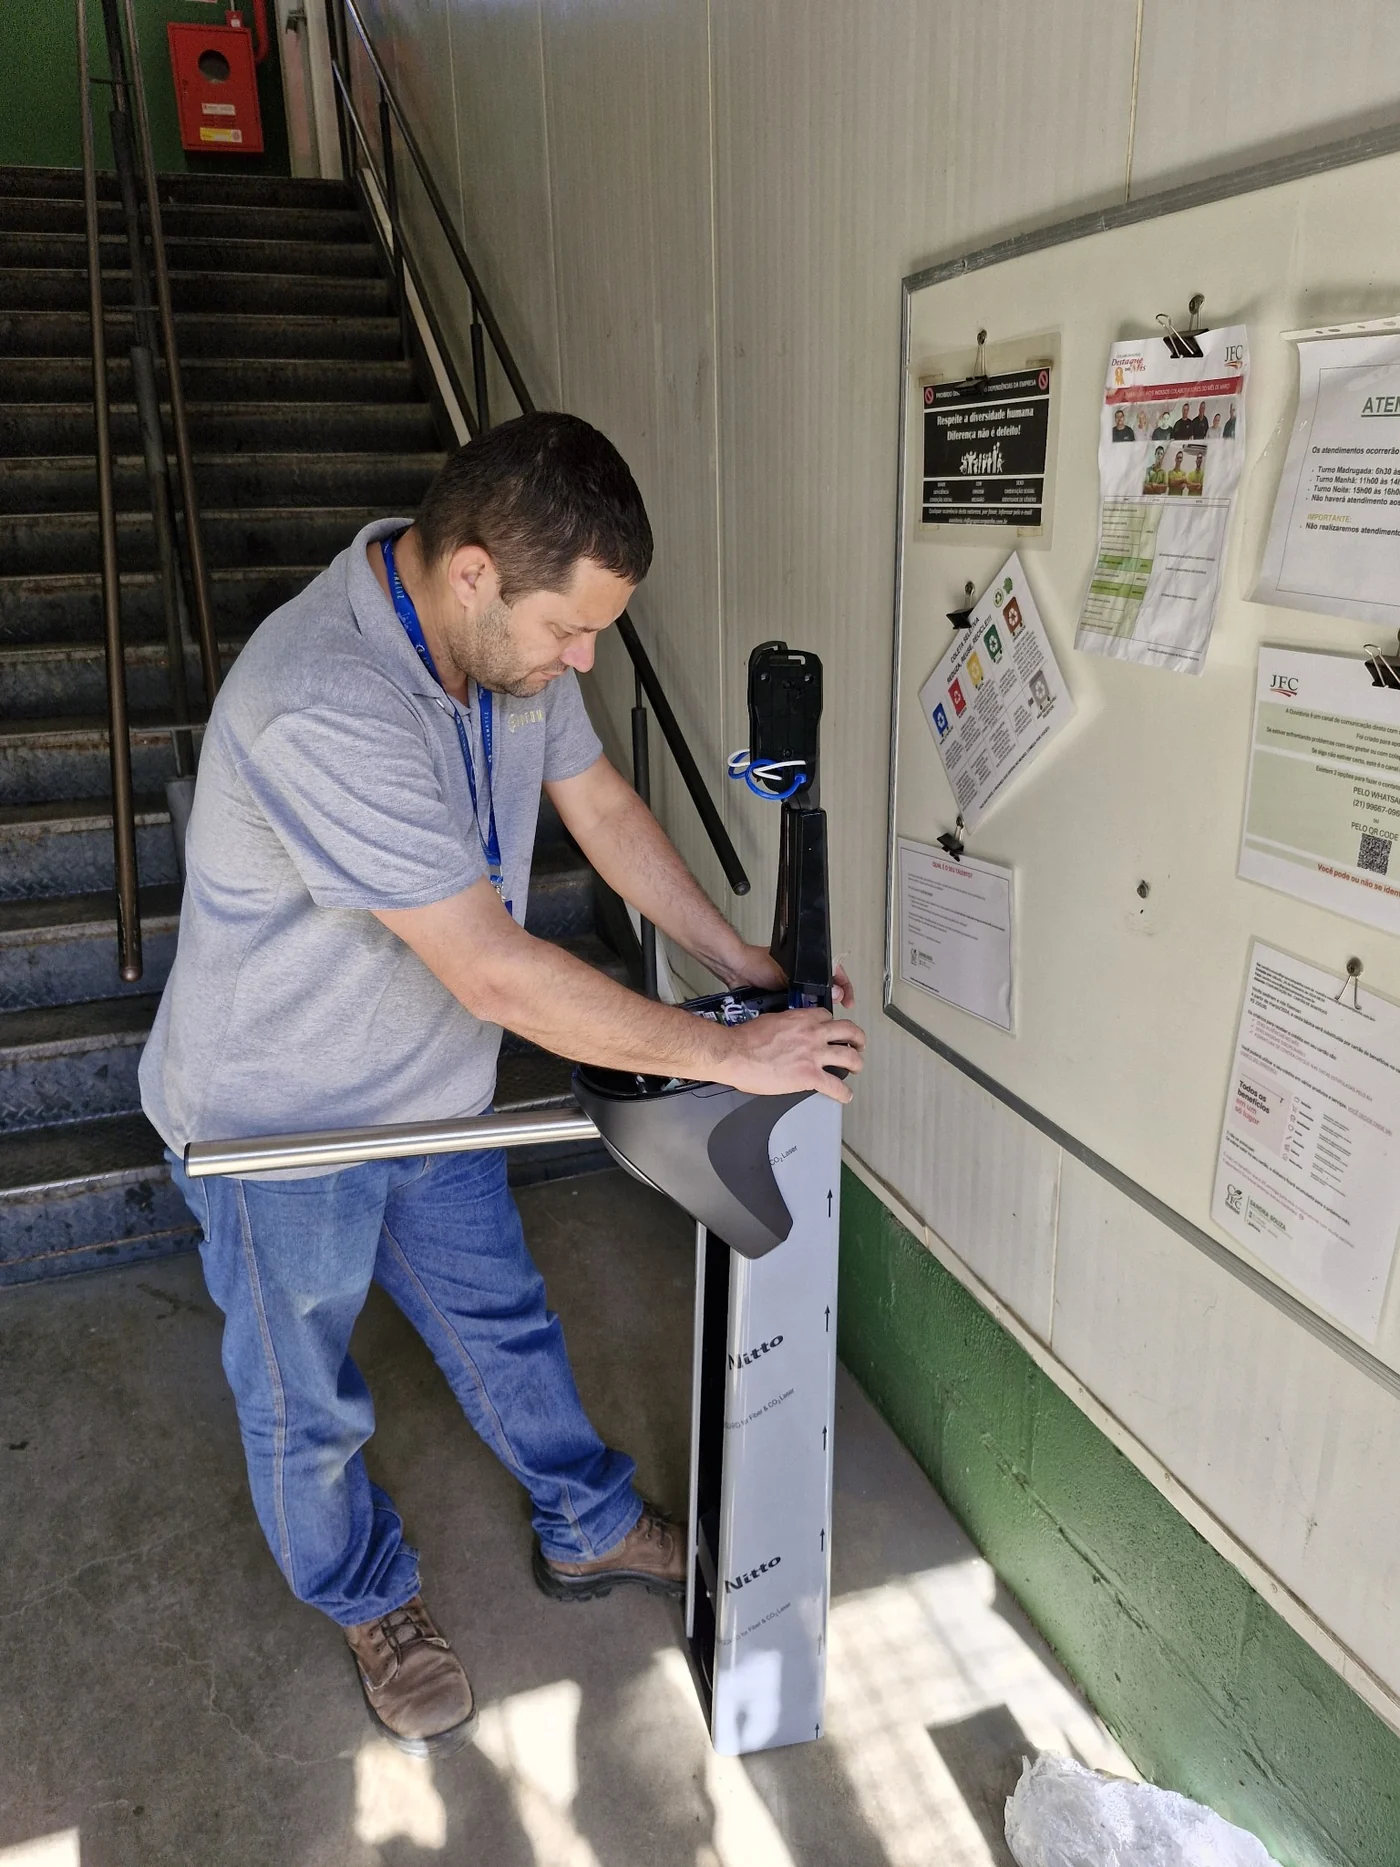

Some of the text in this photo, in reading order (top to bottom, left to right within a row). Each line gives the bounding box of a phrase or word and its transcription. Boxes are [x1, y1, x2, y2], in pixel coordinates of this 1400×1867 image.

[1224, 345, 1243, 362] JFC
[937, 415, 963, 427] Respeite
[970, 410, 1006, 423] diversidade
[1007, 408, 1034, 419] humana
[947, 425, 1021, 441] Diferença não é defeito!
[1366, 446, 1399, 455] ocorrerão
[1335, 476, 1357, 484] Manhã:
[1360, 477, 1378, 485] 11h00
[1380, 477, 1388, 485] às
[1337, 466, 1374, 476] Madrugada:
[1375, 467, 1392, 475] 6h30
[1325, 495, 1345, 503] haverá
[1347, 496, 1388, 505] atendimento
[1373, 487, 1381, 495] às
[1306, 522, 1318, 530] Não
[1319, 523, 1359, 533] realizaremos
[1307, 513, 1352, 523] IMPORTANTE:
[951, 642, 964, 663] COLETA
[947, 663, 962, 684] REDUZA,
[960, 644, 973, 663] REUSE,
[1270, 674, 1299, 691] JFC
[1289, 709, 1309, 717] Ouvidoria
[1341, 719, 1372, 729] comunicação
[1373, 724, 1386, 732] direto
[1311, 736, 1335, 747] problemas
[1355, 745, 1370, 753] gestor
[1377, 749, 1388, 757] com
[1364, 735, 1379, 743] criado
[1380, 738, 1390, 746] para
[1318, 749, 1327, 757] algo
[1337, 754, 1351, 762] estiver
[1352, 756, 1365, 765] certo,
[1366, 760, 1376, 768] este
[1385, 764, 1399, 772] canal
[1316, 765, 1333, 775] Existem
[1337, 771, 1354, 780] opções
[1355, 775, 1365, 783] para
[1366, 777, 1377, 785] fazer
[1353, 786, 1370, 797] PELO
[1353, 799, 1365, 809] (21)
[1351, 822, 1399, 842] PELO QR CODE
[1318, 864, 1333, 875] Você
[1334, 870, 1350, 881] pode
[1361, 878, 1373, 888] não
[1239, 1080, 1266, 1102] Todos os
[1236, 1098, 1257, 1115] em um
[1237, 1088, 1270, 1114] benefícios
[1234, 1105, 1260, 1125] só lugar
[781, 1146, 798, 1158] Laser
[1250, 1200, 1268, 1217] SANDRA
[1270, 1214, 1286, 1231] SOUZA
[728, 1335, 783, 1370] Nitto
[749, 1410, 762, 1421] Fiber
[779, 1388, 794, 1400] Laser
[725, 1556, 781, 1594] Nitto
[748, 1622, 761, 1632] Fiber
[776, 1602, 791, 1614] Laser
